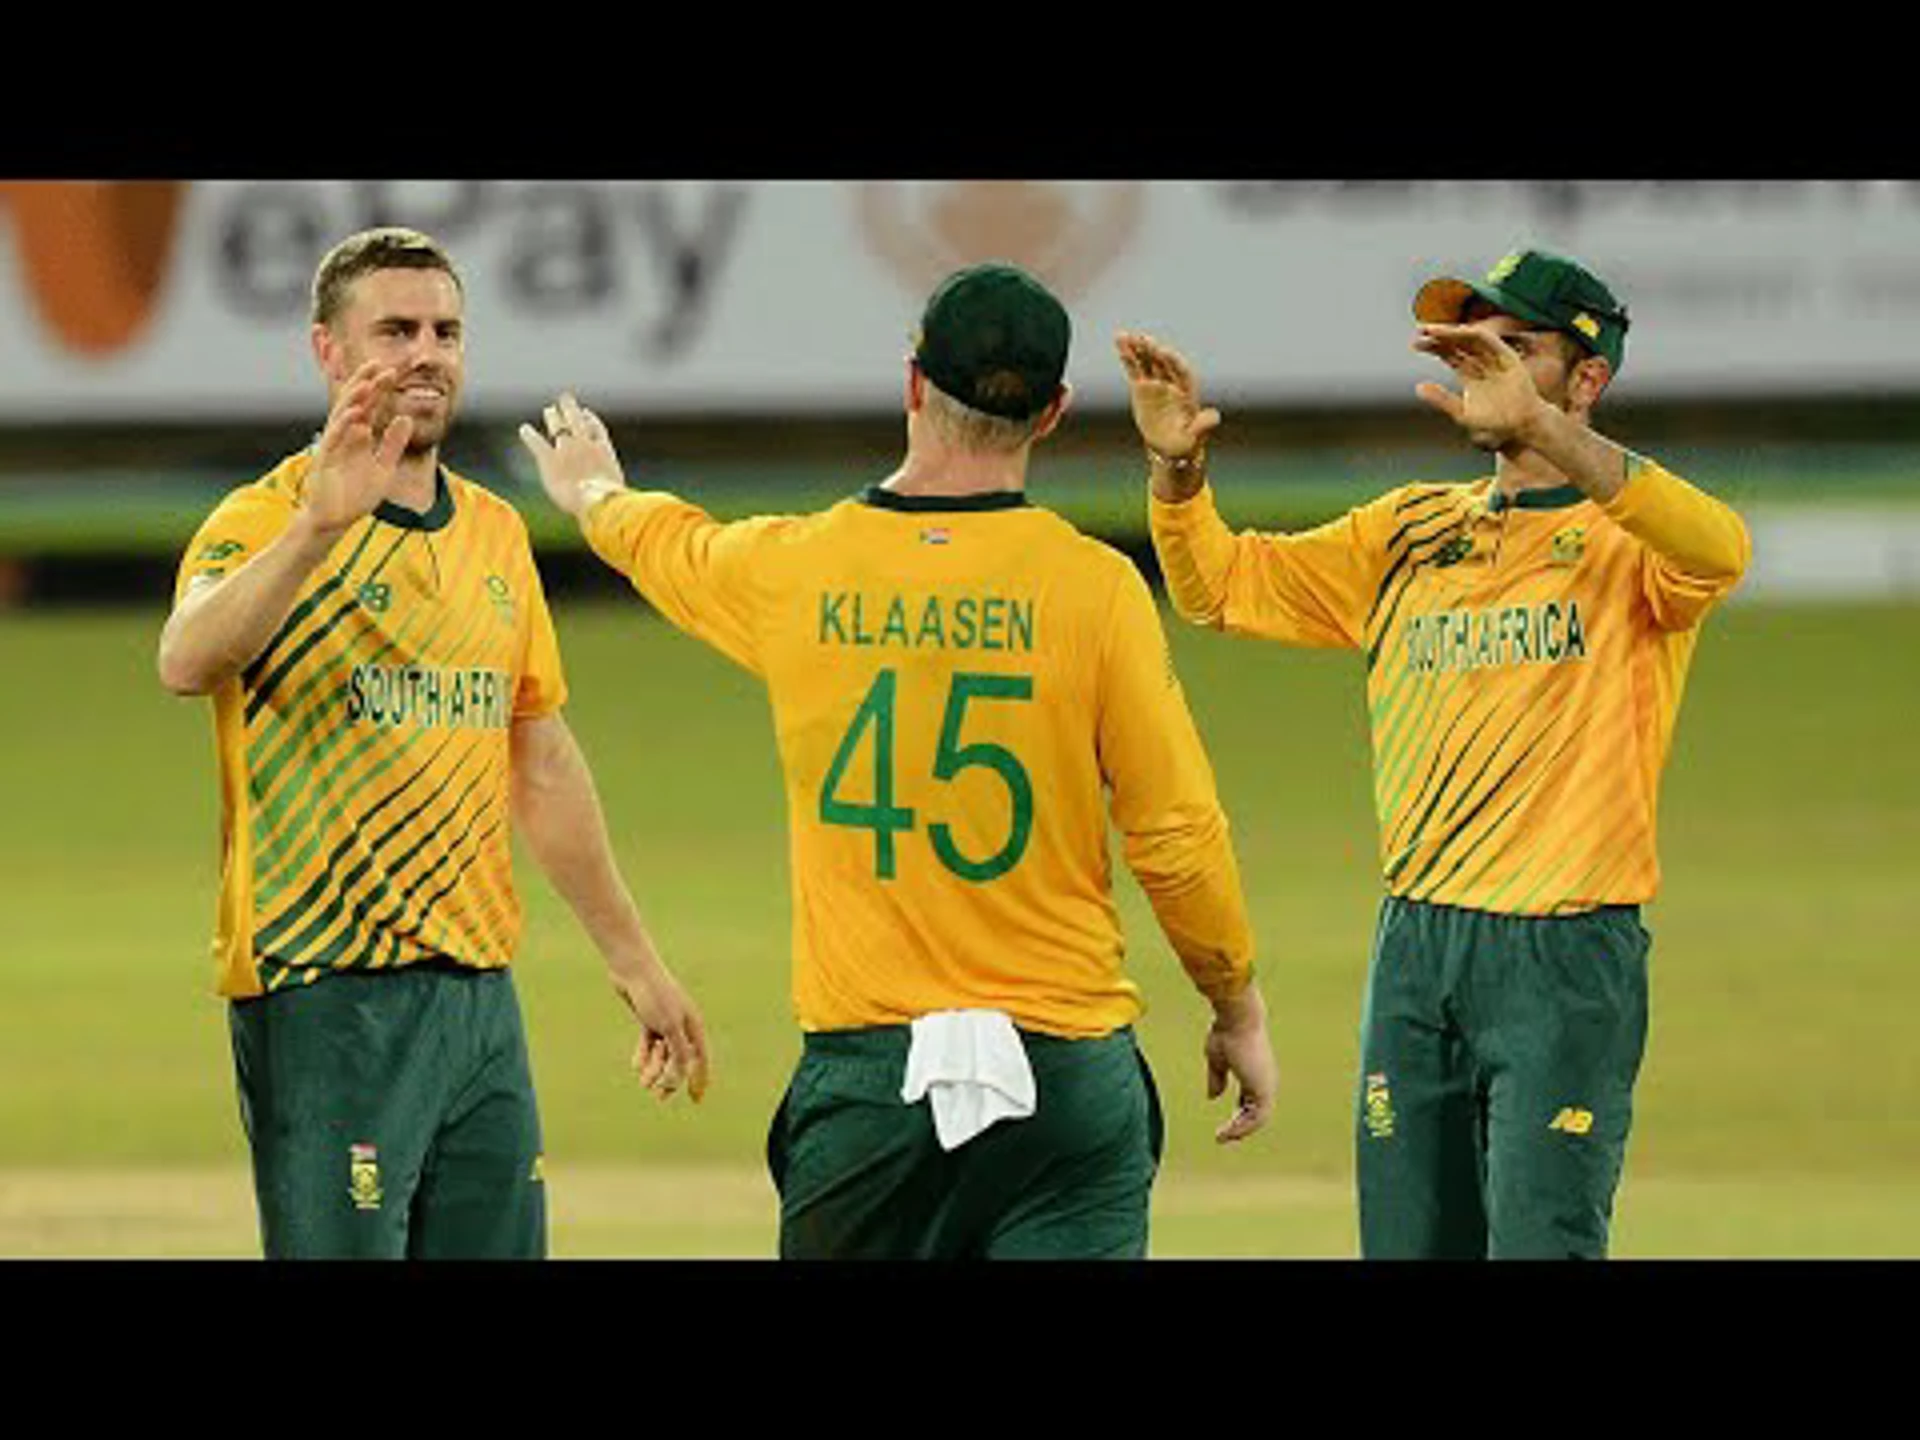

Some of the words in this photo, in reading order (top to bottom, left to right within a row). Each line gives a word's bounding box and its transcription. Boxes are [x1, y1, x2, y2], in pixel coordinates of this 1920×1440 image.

[817, 591, 1035, 652] KLAASEN
[1477, 600, 1586, 664] AFRICA
[347, 667, 440, 728] SOUTH
[819, 669, 1034, 882] 45
